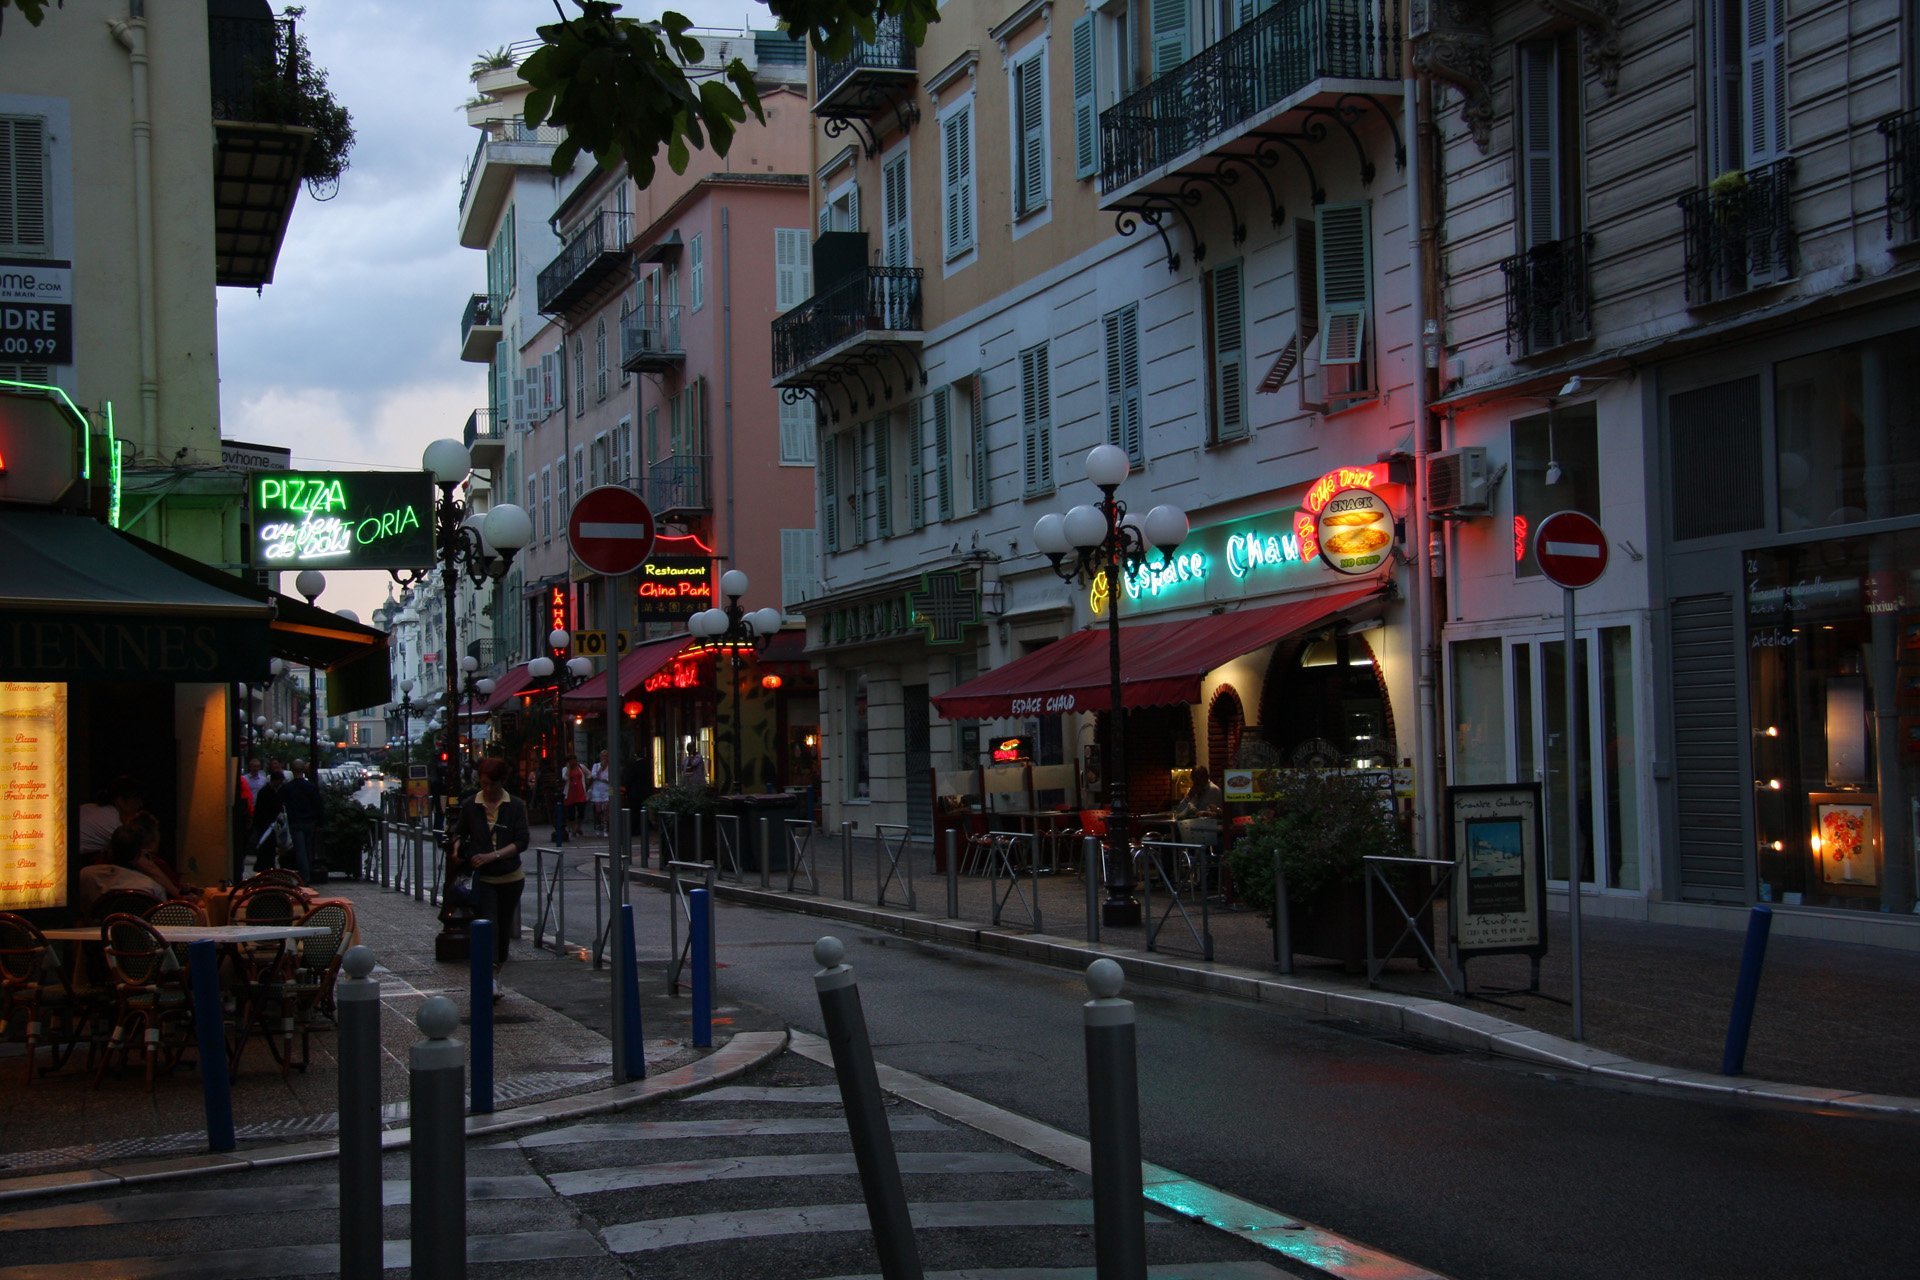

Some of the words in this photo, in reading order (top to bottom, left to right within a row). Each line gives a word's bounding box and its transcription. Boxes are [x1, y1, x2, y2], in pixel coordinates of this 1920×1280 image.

[0, 273, 61, 291] me.COM
[0, 309, 56, 331] DRE
[261, 479, 347, 511] PIZZA
[1310, 475, 1336, 512] Café
[1330, 496, 1373, 513] SNACK
[1226, 532, 1300, 578] Chau
[1340, 558, 1356, 568] NO
[1356, 554, 1381, 567] STOP
[645, 564, 706, 576] Restaurant
[639, 583, 676, 597] China
[679, 582, 710, 597] Park
[4, 621, 219, 672] IENNES
[1751, 628, 1798, 649] Atelier
[1011, 697, 1042, 714] ESPACE
[1046, 694, 1075, 712] CHAUD
